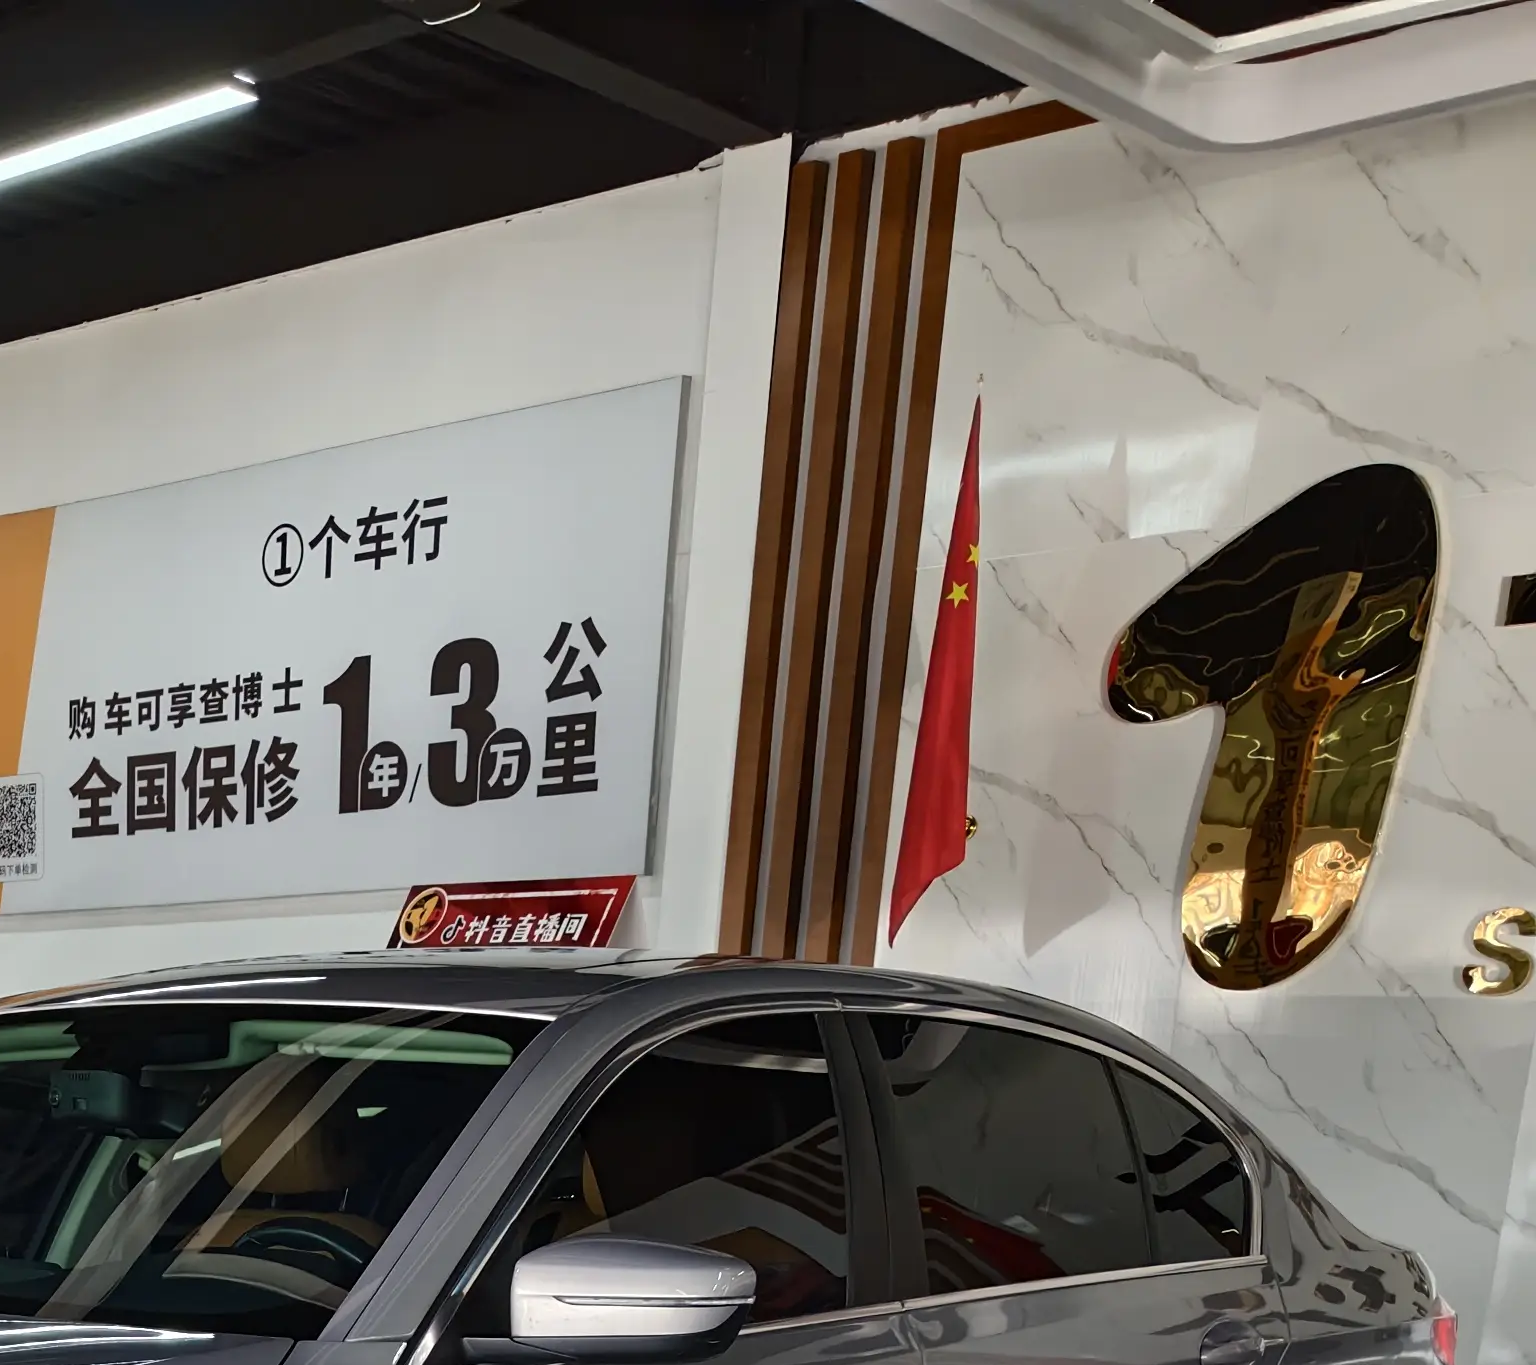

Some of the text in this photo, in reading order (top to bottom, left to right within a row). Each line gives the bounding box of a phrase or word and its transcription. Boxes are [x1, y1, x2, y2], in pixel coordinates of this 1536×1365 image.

[68, 667, 303, 740] 购车可享查博士
[69, 736, 300, 838] 全国保修
[464, 912, 589, 945] 抖音直播间
